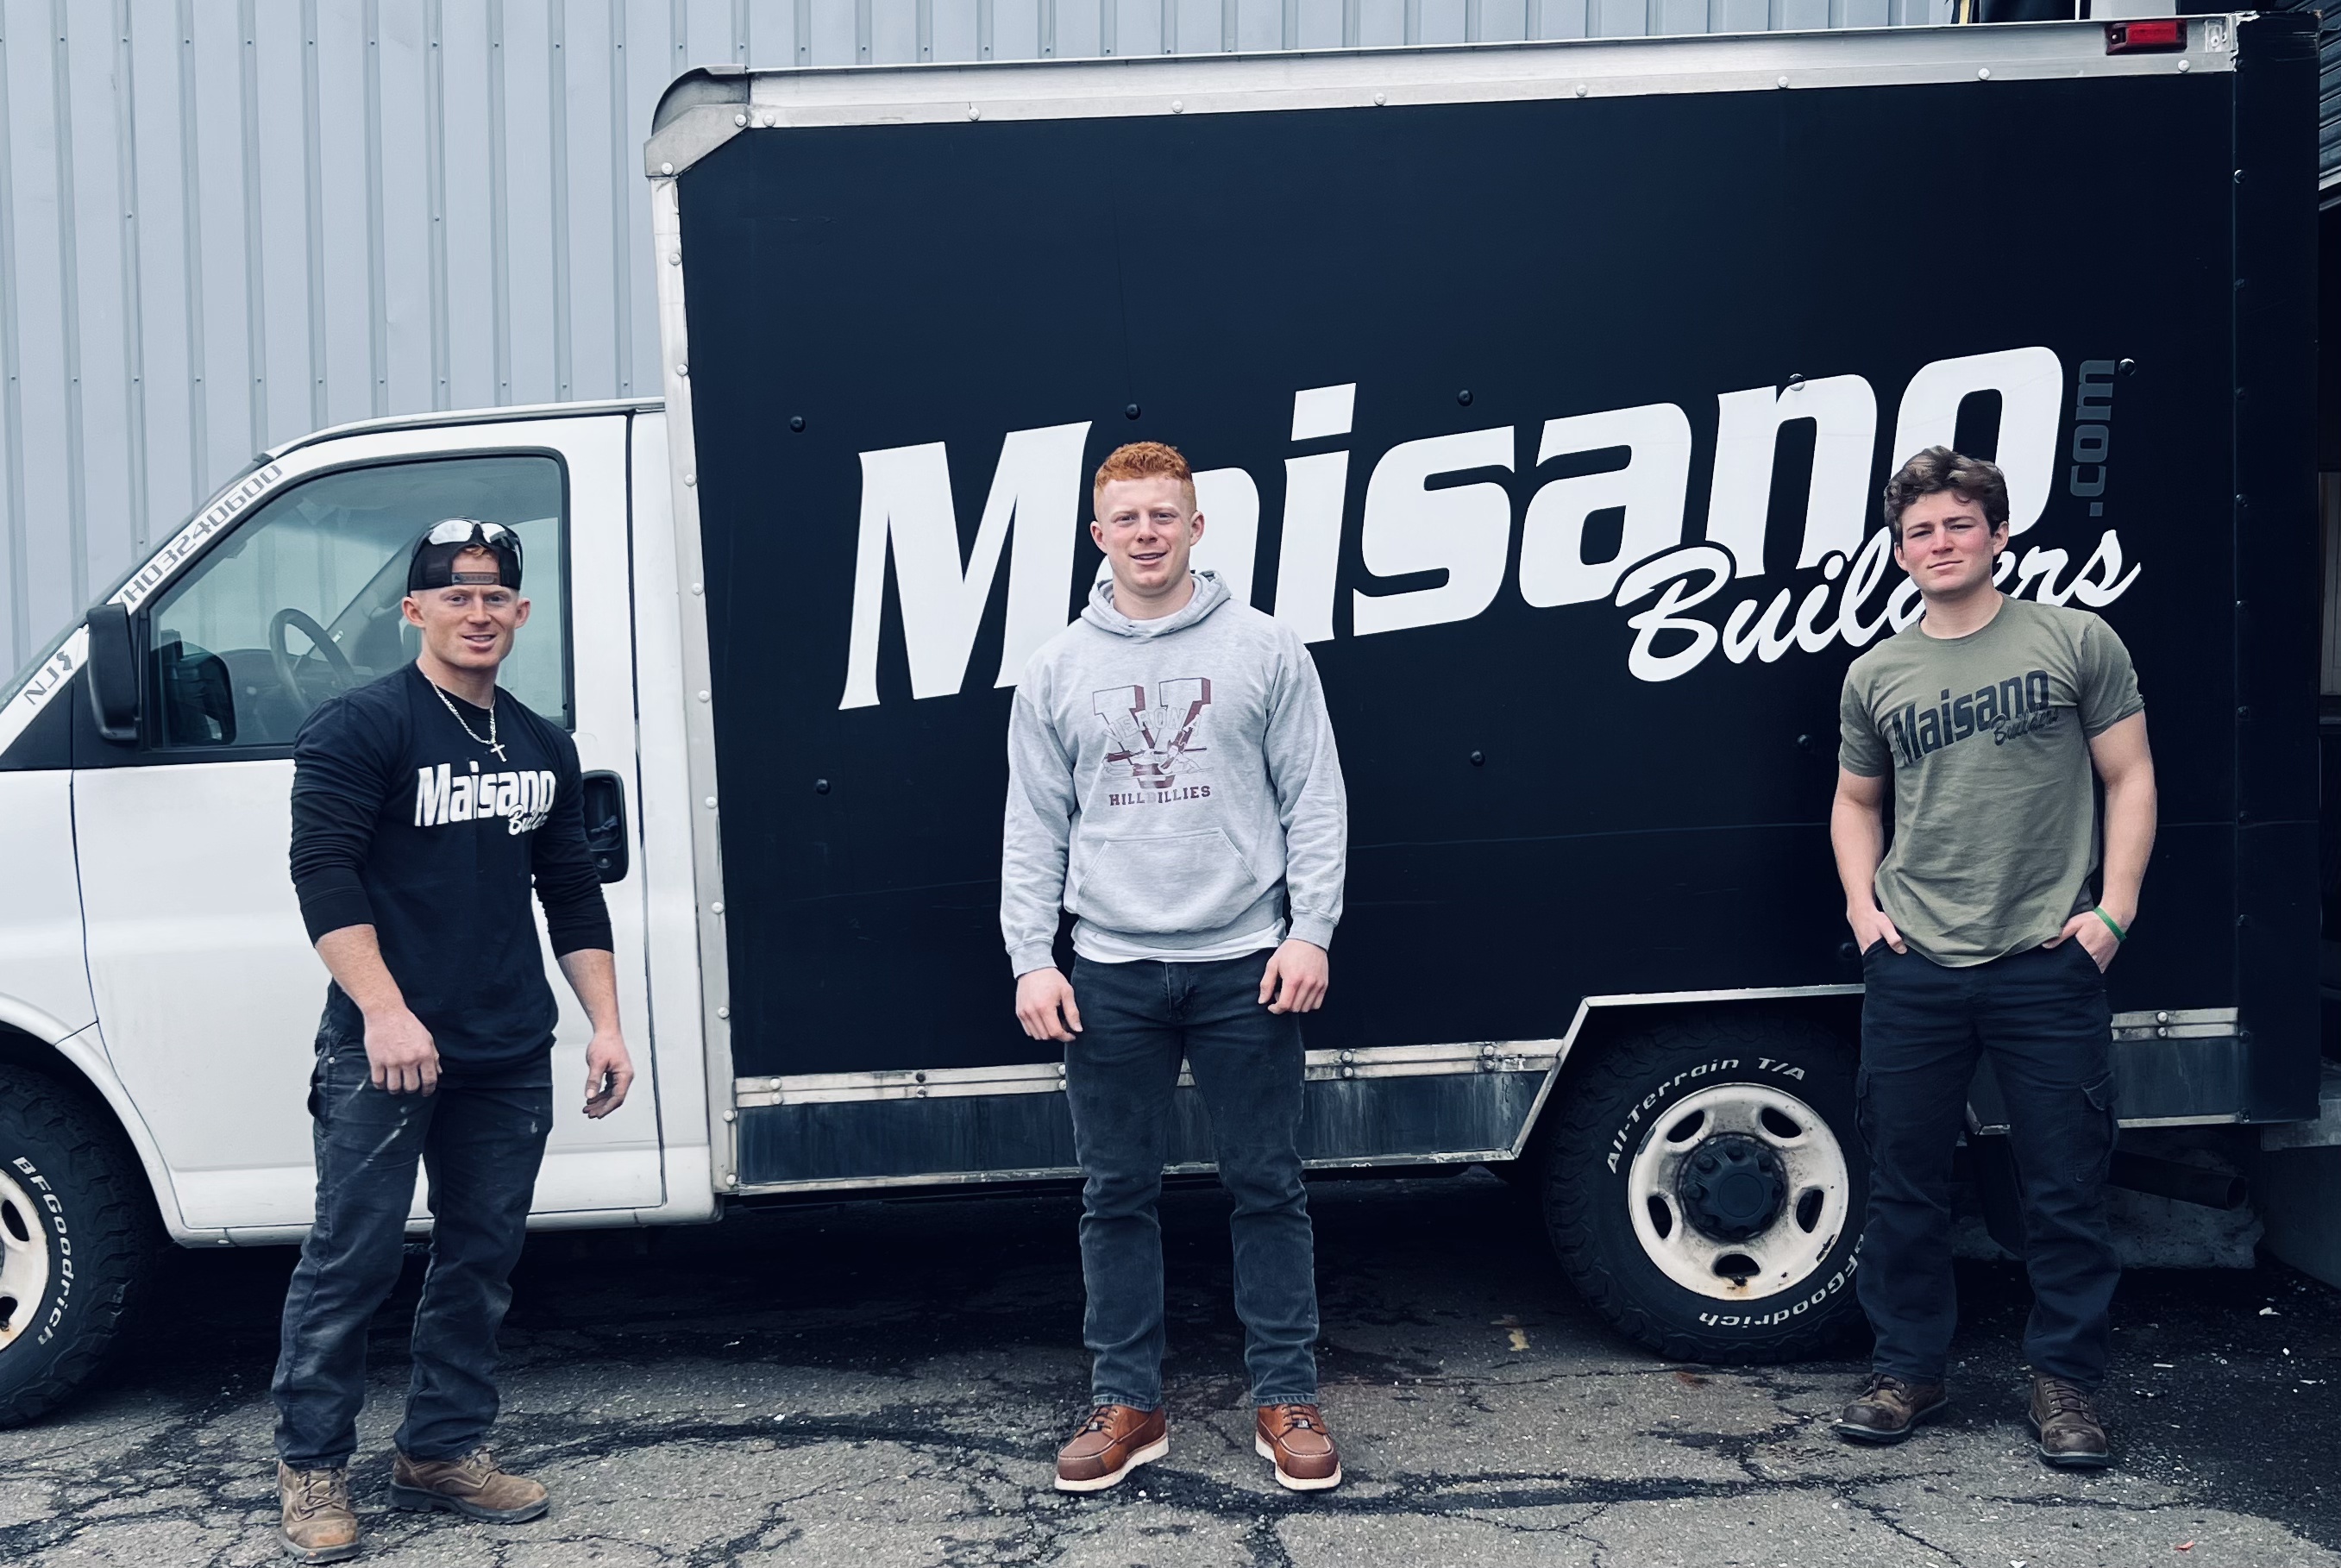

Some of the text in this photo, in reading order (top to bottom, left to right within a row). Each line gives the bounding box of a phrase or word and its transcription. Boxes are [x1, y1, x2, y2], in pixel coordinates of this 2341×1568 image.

[2070, 360, 2115, 517] .com
[23, 464, 283, 706] NJ H03240600
[1101, 706, 1202, 745] VERONA
[1892, 669, 2049, 764] Maisano
[414, 761, 556, 827] Maisano
[1108, 785, 1211, 806] HILLBILLIES
[1607, 1057, 1805, 1174] All-Terrain T/A
[13, 1157, 74, 1345] BFGoodrich
